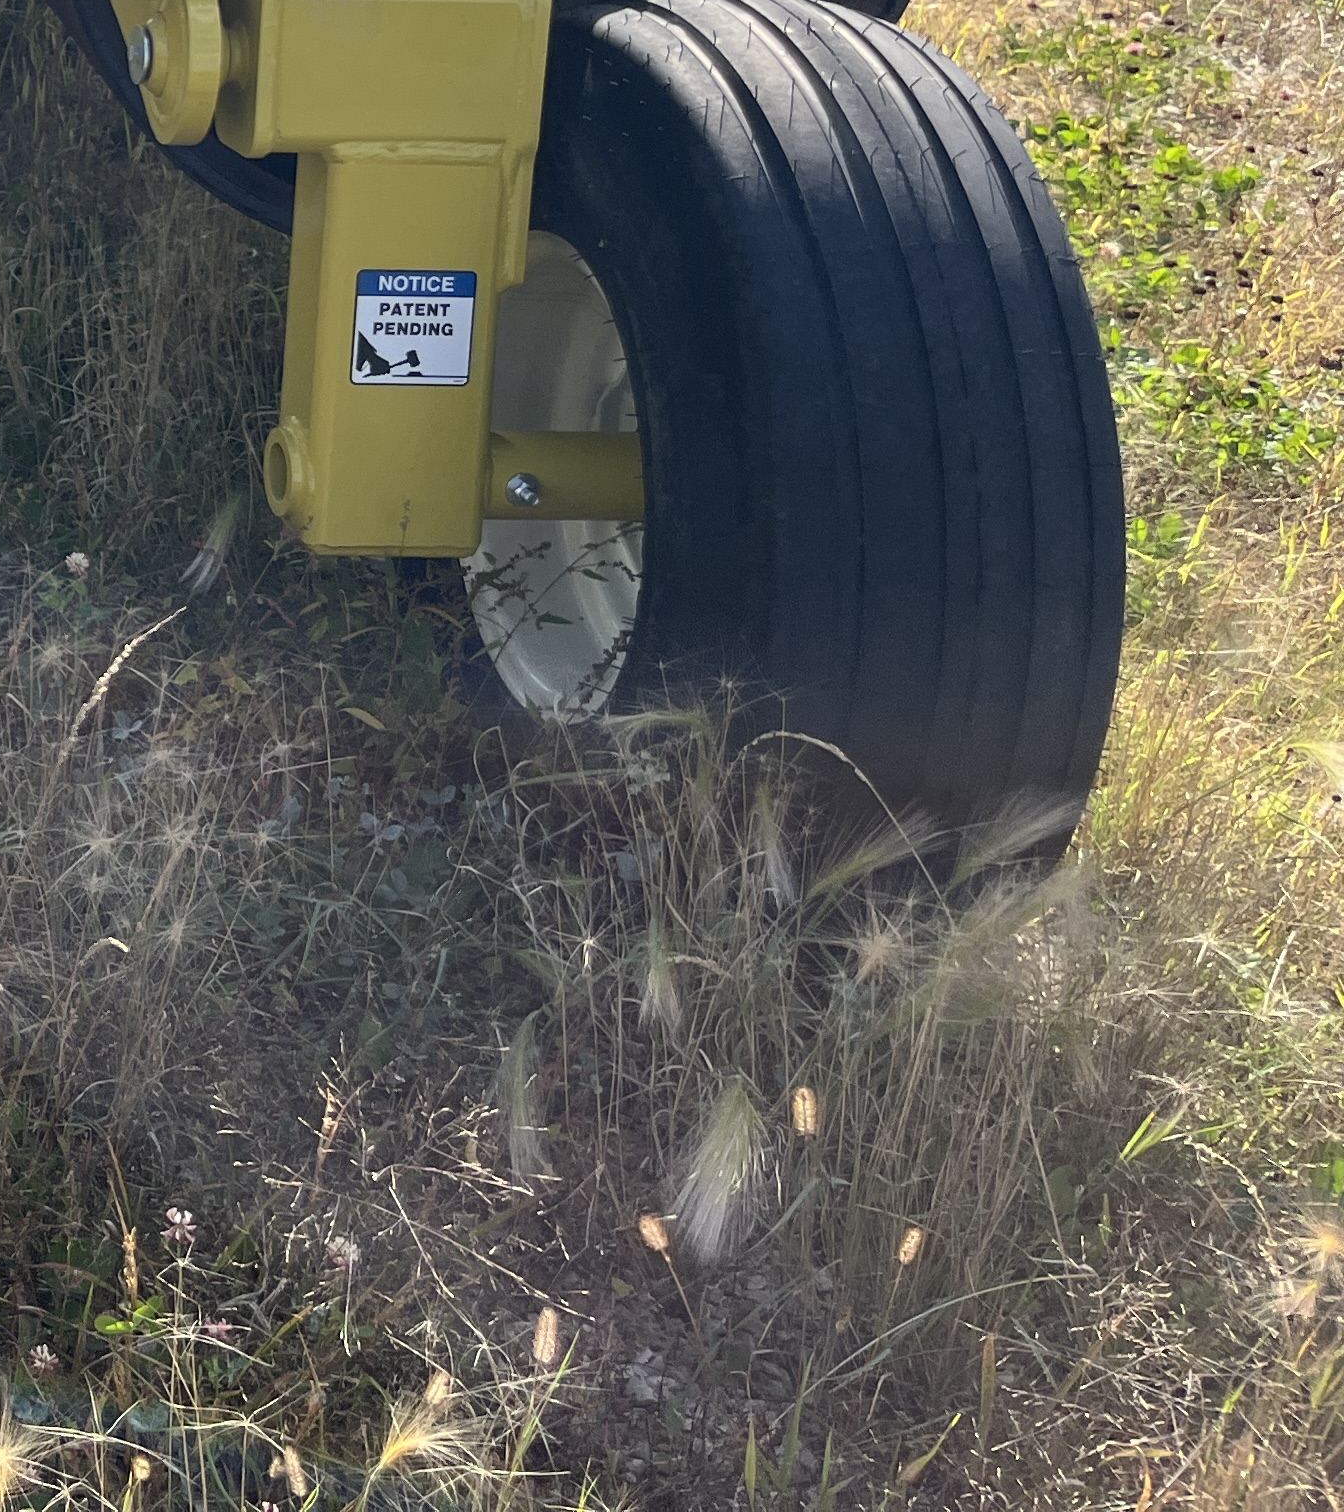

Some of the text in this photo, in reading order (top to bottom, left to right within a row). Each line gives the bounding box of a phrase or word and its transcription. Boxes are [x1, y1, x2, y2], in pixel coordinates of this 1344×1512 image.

[378, 275, 455, 293] NOTICE
[379, 302, 451, 317] PATENT
[373, 322, 454, 336] PENDING
